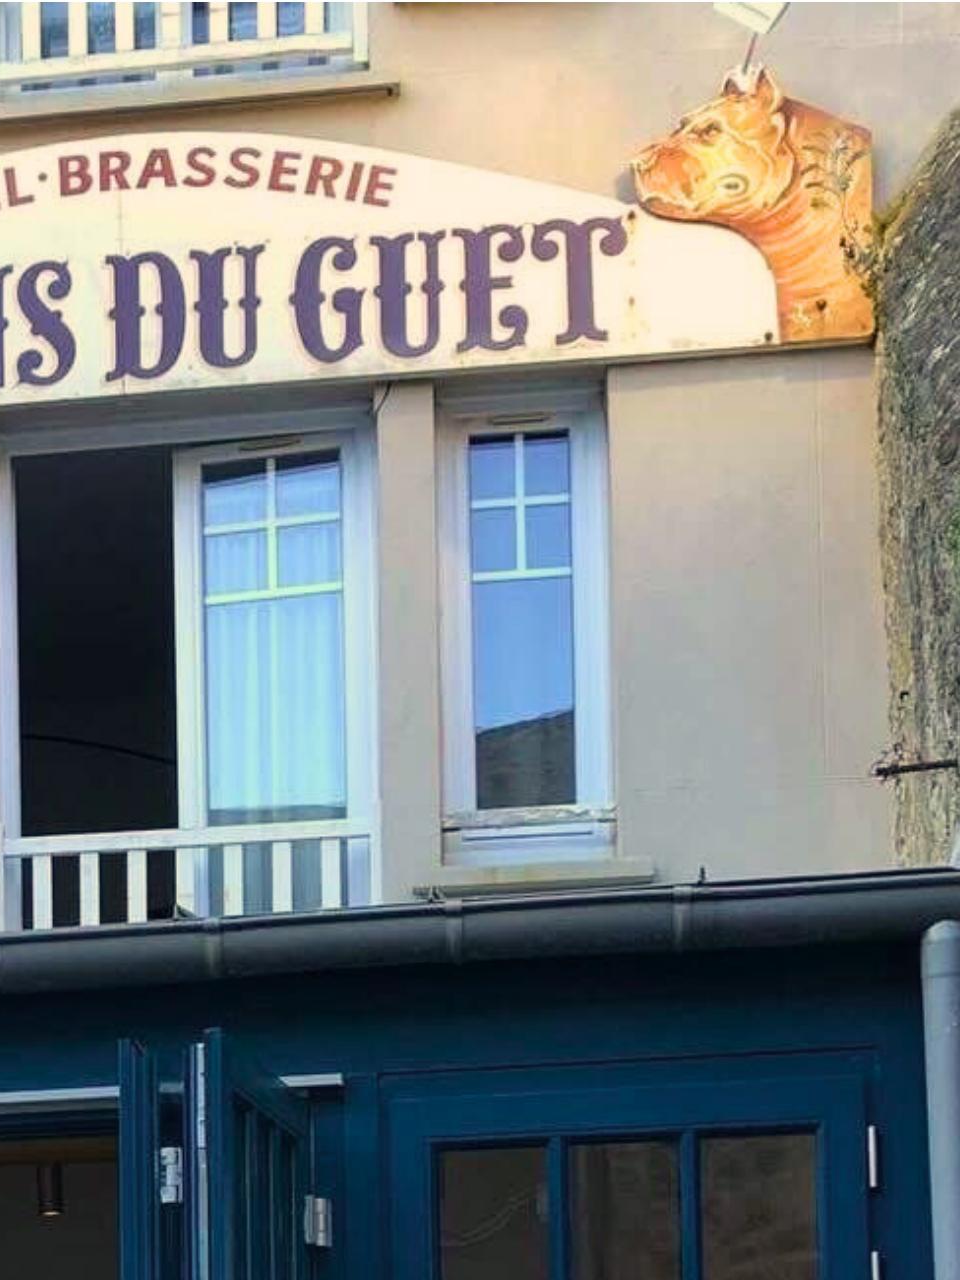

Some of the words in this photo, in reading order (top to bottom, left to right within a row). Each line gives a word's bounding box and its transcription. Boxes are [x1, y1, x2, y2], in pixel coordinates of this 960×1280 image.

[58, 147, 398, 208] BRASSERIE
[104, 241, 270, 383] DU
[288, 216, 629, 364] GUET
